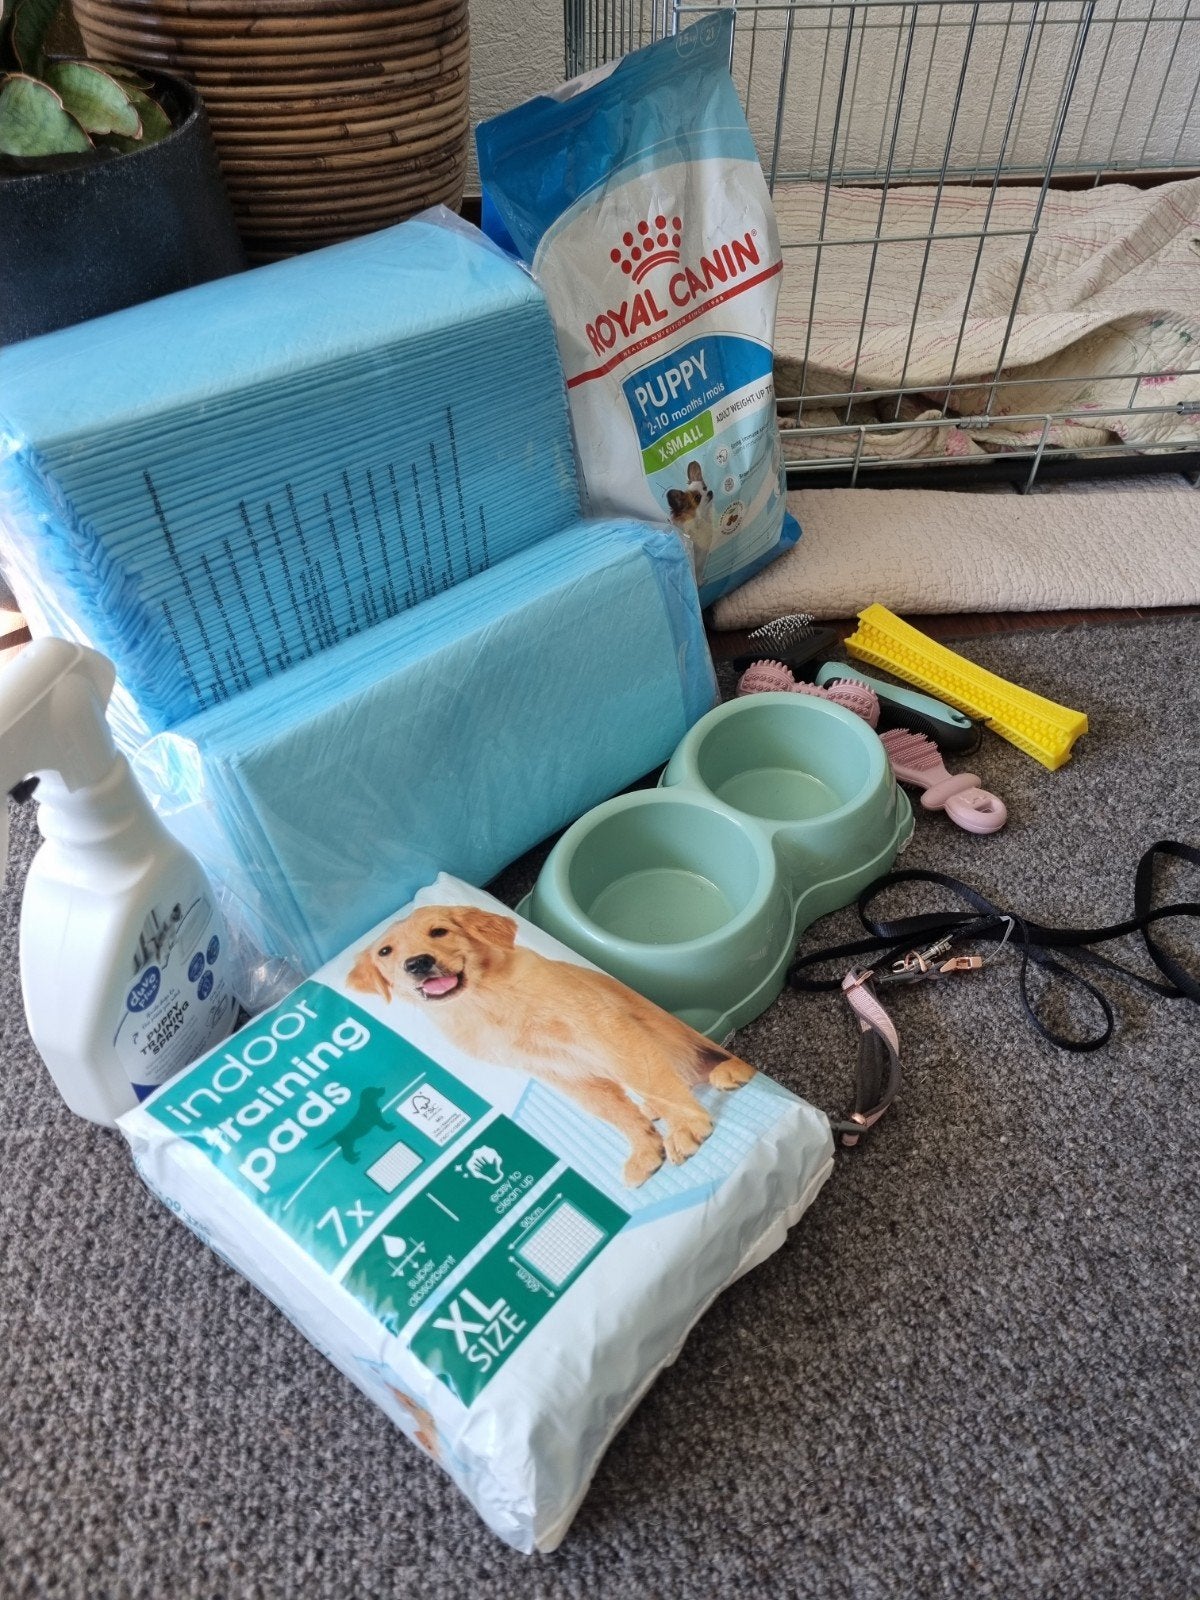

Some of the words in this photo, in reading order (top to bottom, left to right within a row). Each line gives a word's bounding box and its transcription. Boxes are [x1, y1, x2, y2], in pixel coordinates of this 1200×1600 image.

[585, 289, 668, 357] ROYAL
[668, 232, 760, 307] CANIN
[623, 338, 649, 357] HEALTH
[651, 320, 687, 341] NUTRITION
[635, 349, 708, 417] PUPPY
[716, 408, 731, 424] ADULT
[730, 394, 755, 413] WEIGHT
[755, 388, 765, 401] UP
[647, 413, 669, 436] 2-10
[658, 425, 704, 463] X-SMALL
[130, 973, 157, 1007] duvo
[141, 1000, 190, 1055] TRAINING
[146, 1001, 179, 1041] PUPPY
[152, 1016, 185, 1055] SPRAY
[165, 999, 318, 1125] indoor
[201, 1016, 371, 1154] training
[238, 1081, 351, 1194] pads
[495, 1186, 522, 1214] clean
[521, 1174, 535, 1191] up
[432, 1288, 507, 1354] XL
[466, 1304, 528, 1373] SIZE
